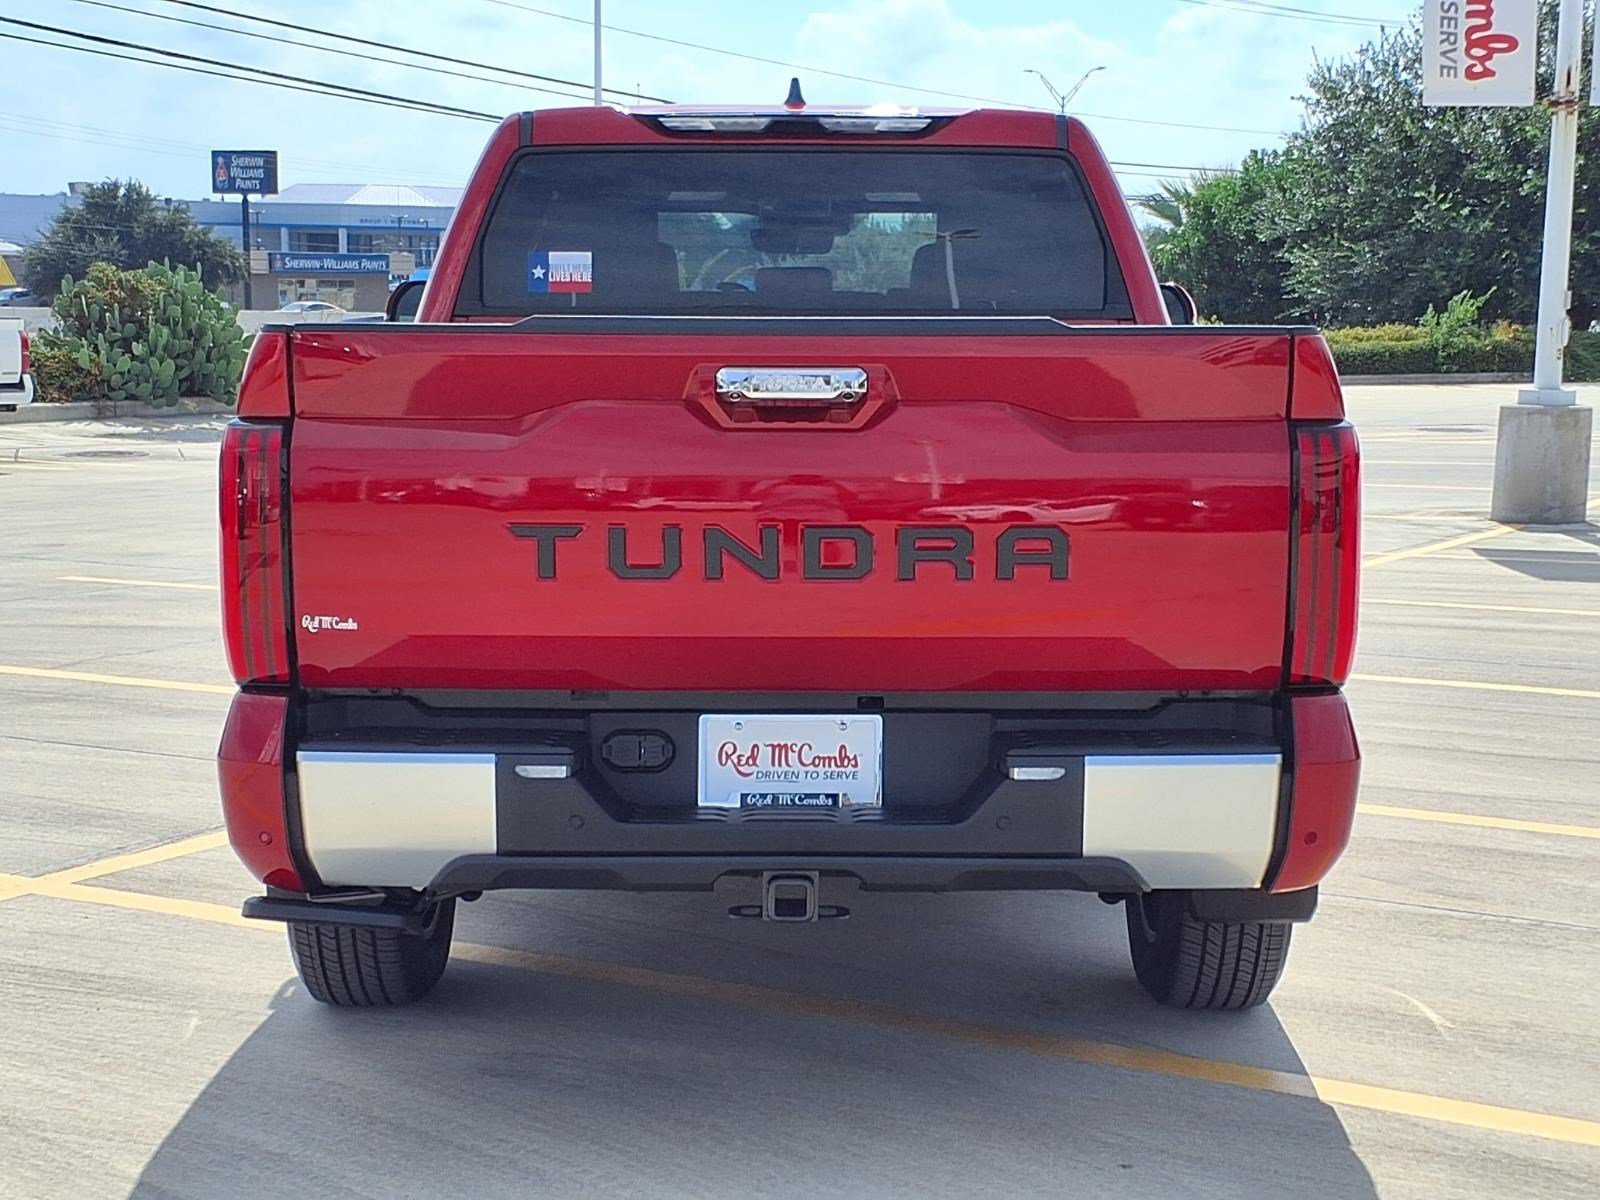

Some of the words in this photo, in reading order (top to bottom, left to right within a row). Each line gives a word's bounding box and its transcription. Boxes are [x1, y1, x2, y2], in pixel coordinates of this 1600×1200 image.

[1439, 0, 1459, 79] SERVE
[231, 155, 264, 167] SHERWIN
[230, 166, 265, 178] WILLIAMS
[235, 178, 261, 190] PAINTS
[361, 258, 387, 271] PAINTS
[549, 271, 571, 282] LIVES
[571, 271, 592, 282] HERE
[508, 523, 1070, 581] TUNDRA
[718, 741, 760, 778] Red
[764, 742, 859, 769] McCombs
[755, 770, 800, 781] DRIVEN
[804, 770, 820, 780] TO
[823, 770, 859, 780] SERVE
[747, 793, 773, 807] Red
[775, 794, 833, 806] McCombs
